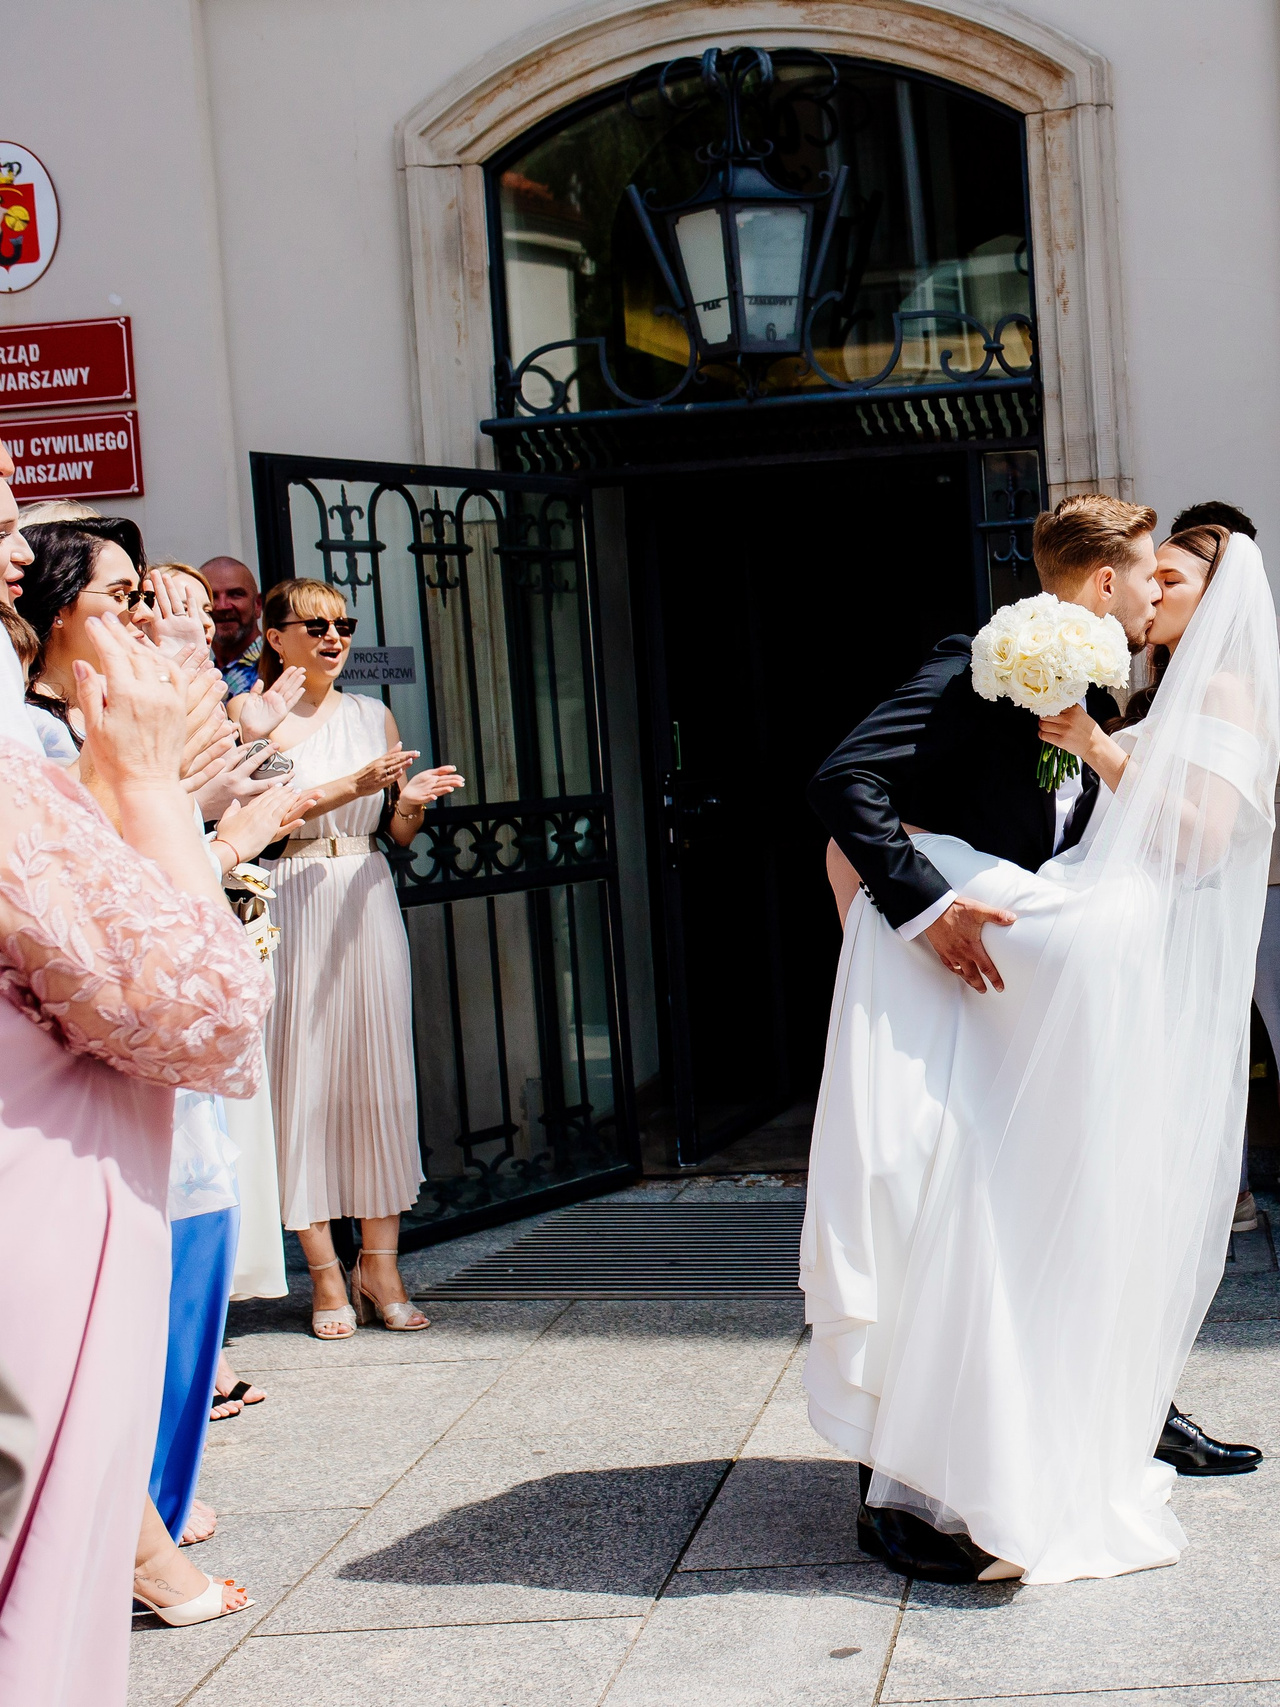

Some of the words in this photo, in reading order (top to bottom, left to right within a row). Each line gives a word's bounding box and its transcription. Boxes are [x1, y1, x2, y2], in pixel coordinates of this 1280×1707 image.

[765, 322, 777, 341] 6
[30, 430, 128, 456] CYWILNEGO
[353, 652, 389, 665] PROSZĘ
[338, 665, 380, 680] AMYKAĆ
[382, 667, 413, 679] DRZWI
